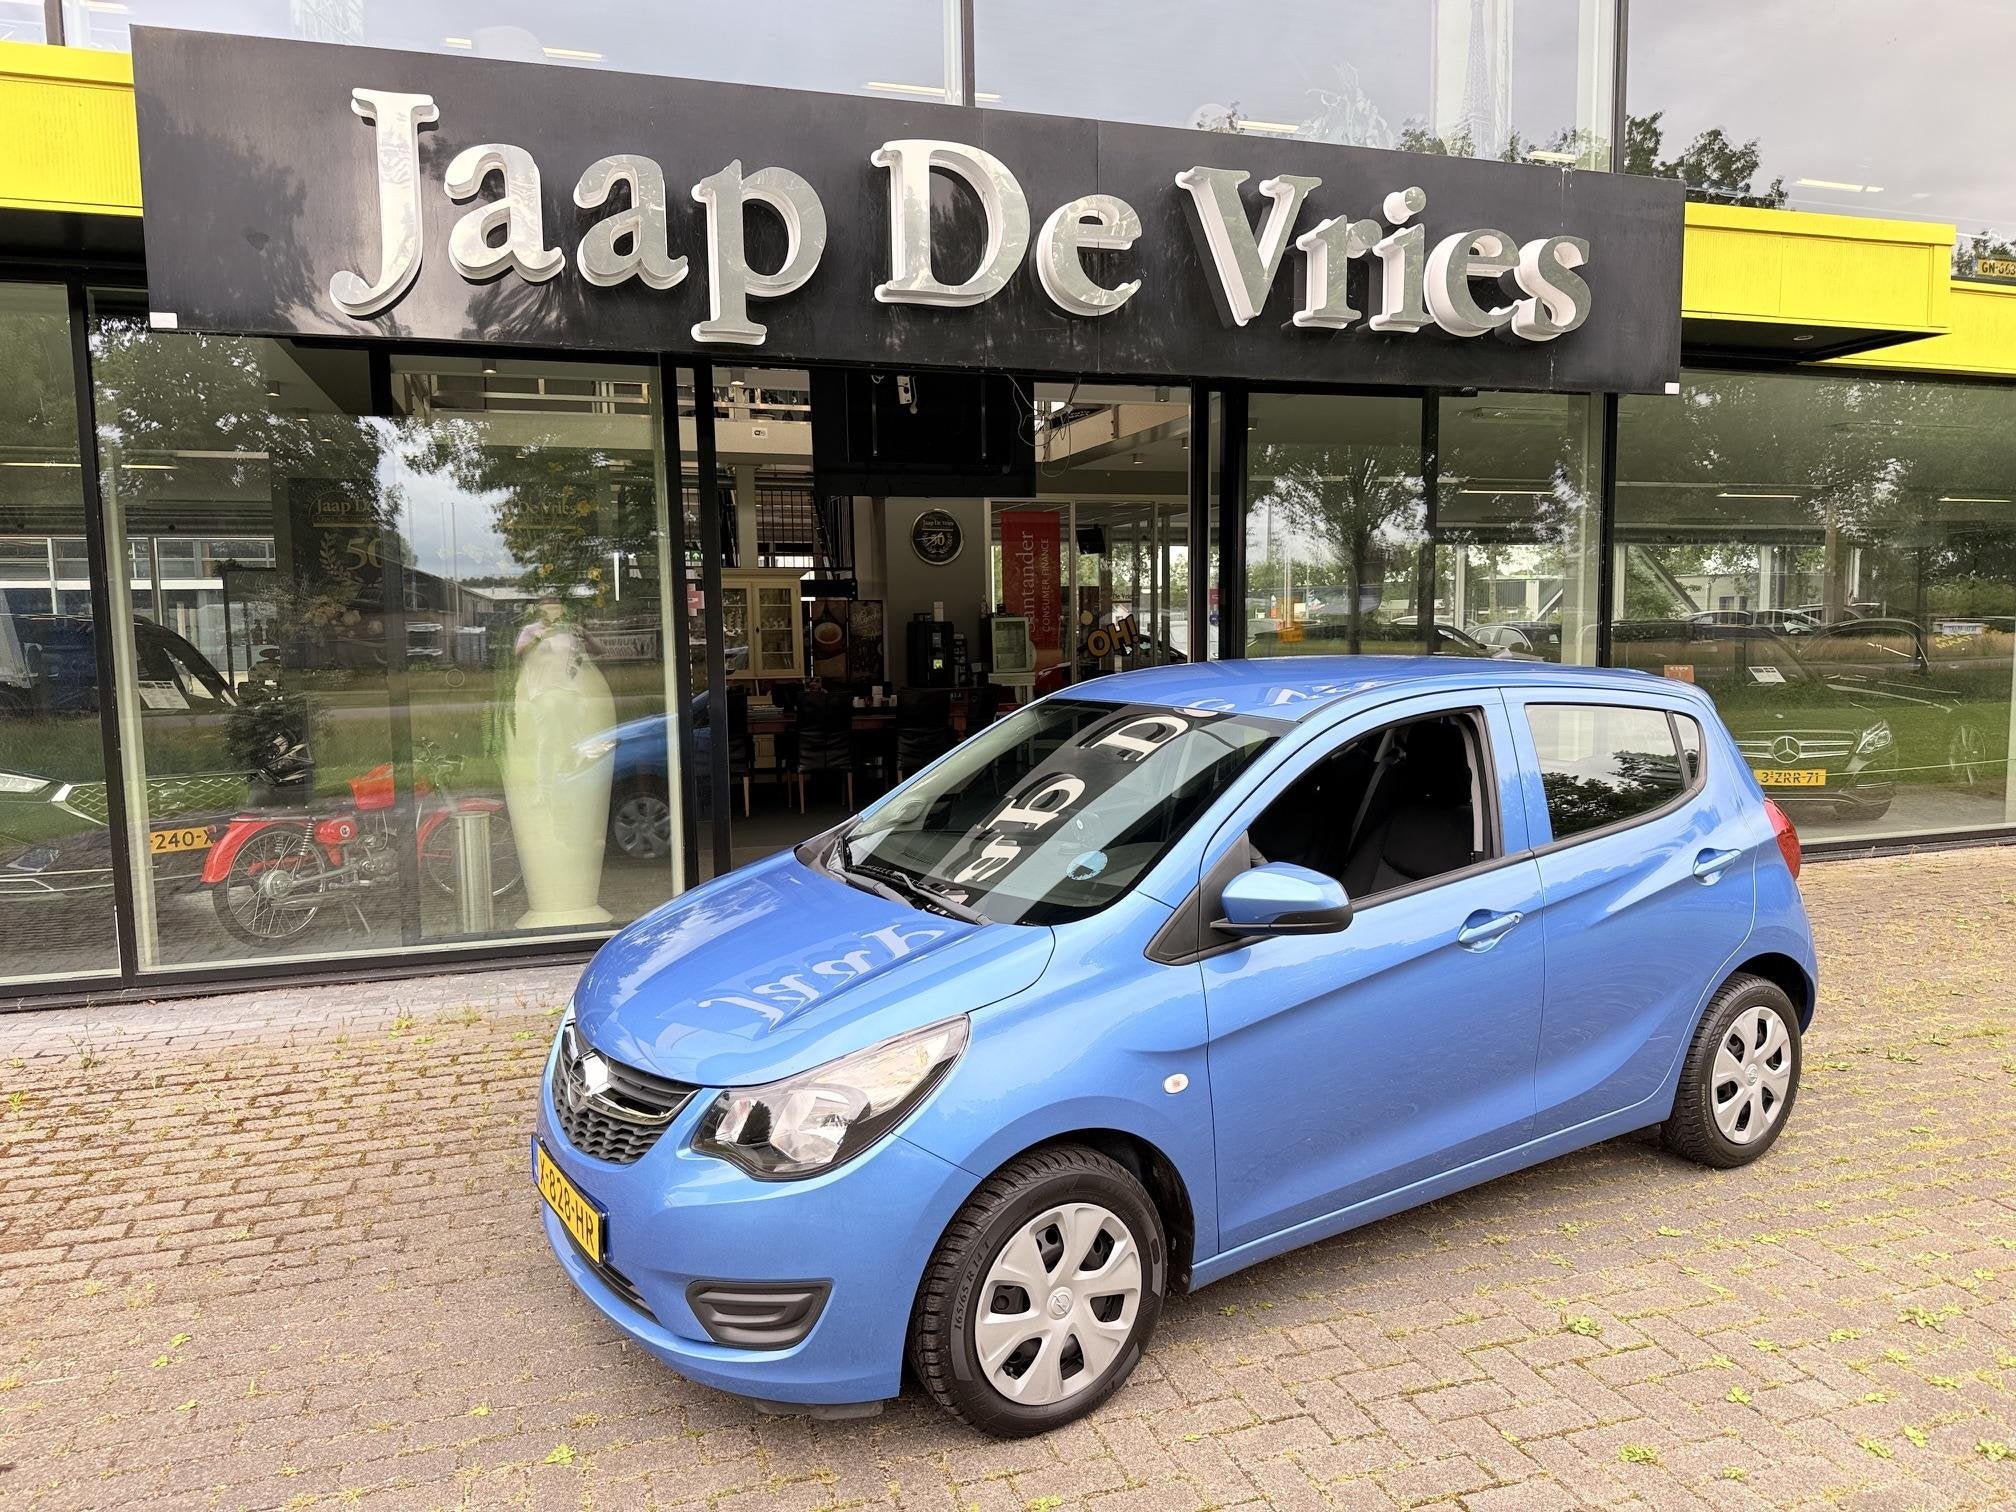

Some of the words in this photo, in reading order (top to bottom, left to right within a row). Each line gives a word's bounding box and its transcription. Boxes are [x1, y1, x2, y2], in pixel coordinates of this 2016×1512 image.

[328, 87, 828, 347] Jaap
[870, 138, 1142, 316] De
[1174, 165, 1593, 343] Vries
[1087, 613, 1139, 658] OH!
